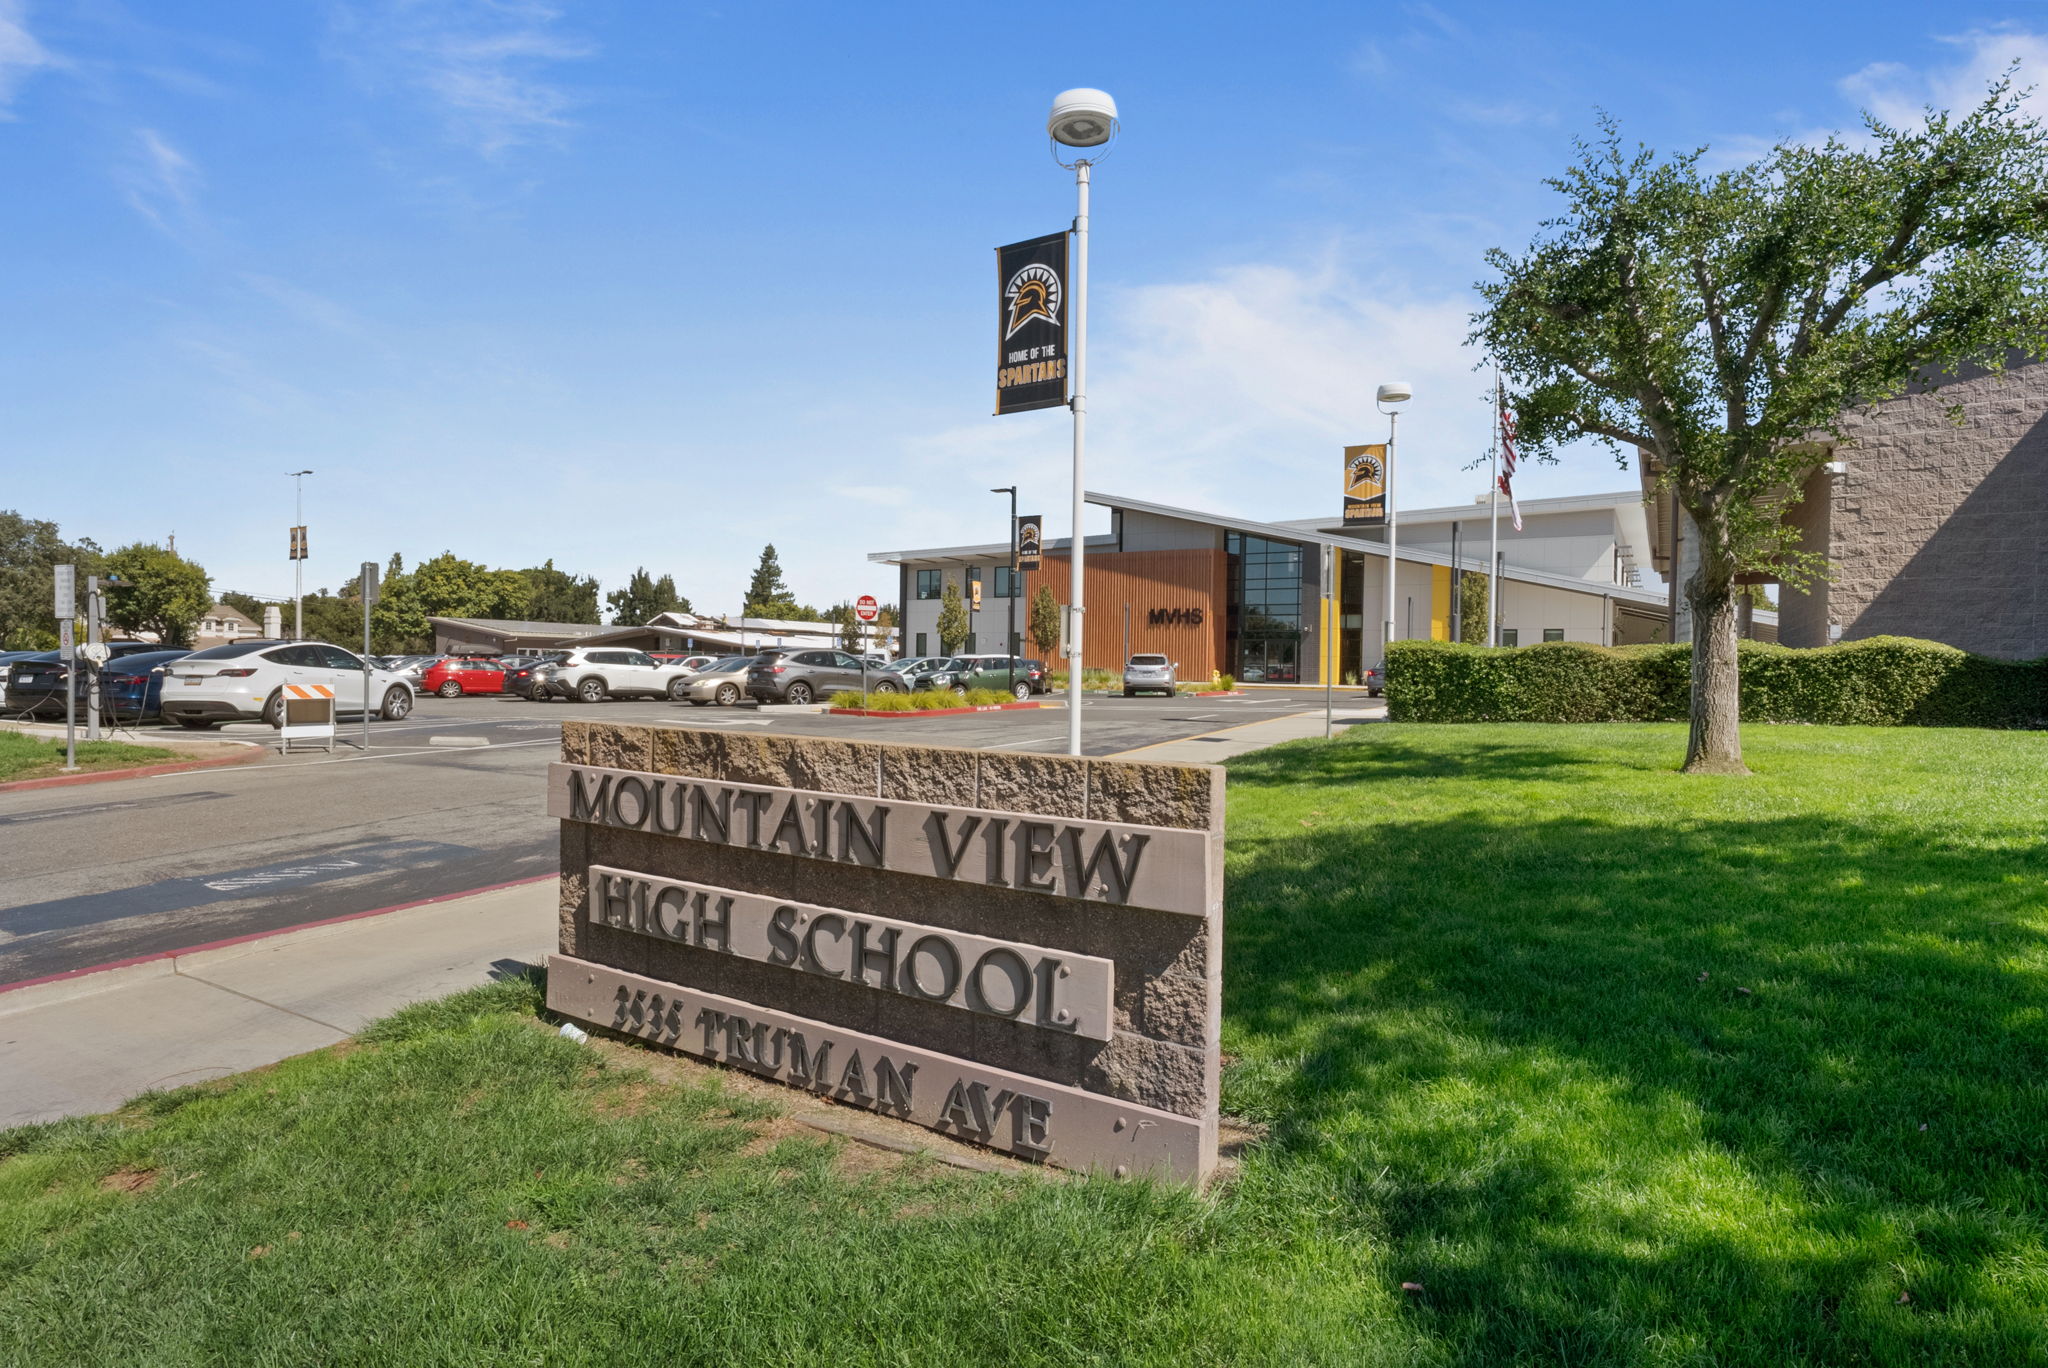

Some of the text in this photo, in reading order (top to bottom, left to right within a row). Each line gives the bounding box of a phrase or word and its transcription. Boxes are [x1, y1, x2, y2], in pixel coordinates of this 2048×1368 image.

[999, 359, 1066, 388] SPARTANS
[1009, 345, 1055, 363] HOME OF THE
[1149, 608, 1203, 625] MVHS
[570, 769, 1151, 905] MOUNTAIN VIEW
[600, 873, 1081, 1033] HIGH SCHOOL
[613, 984, 1054, 1150] 3535 TRUMAN AVE
